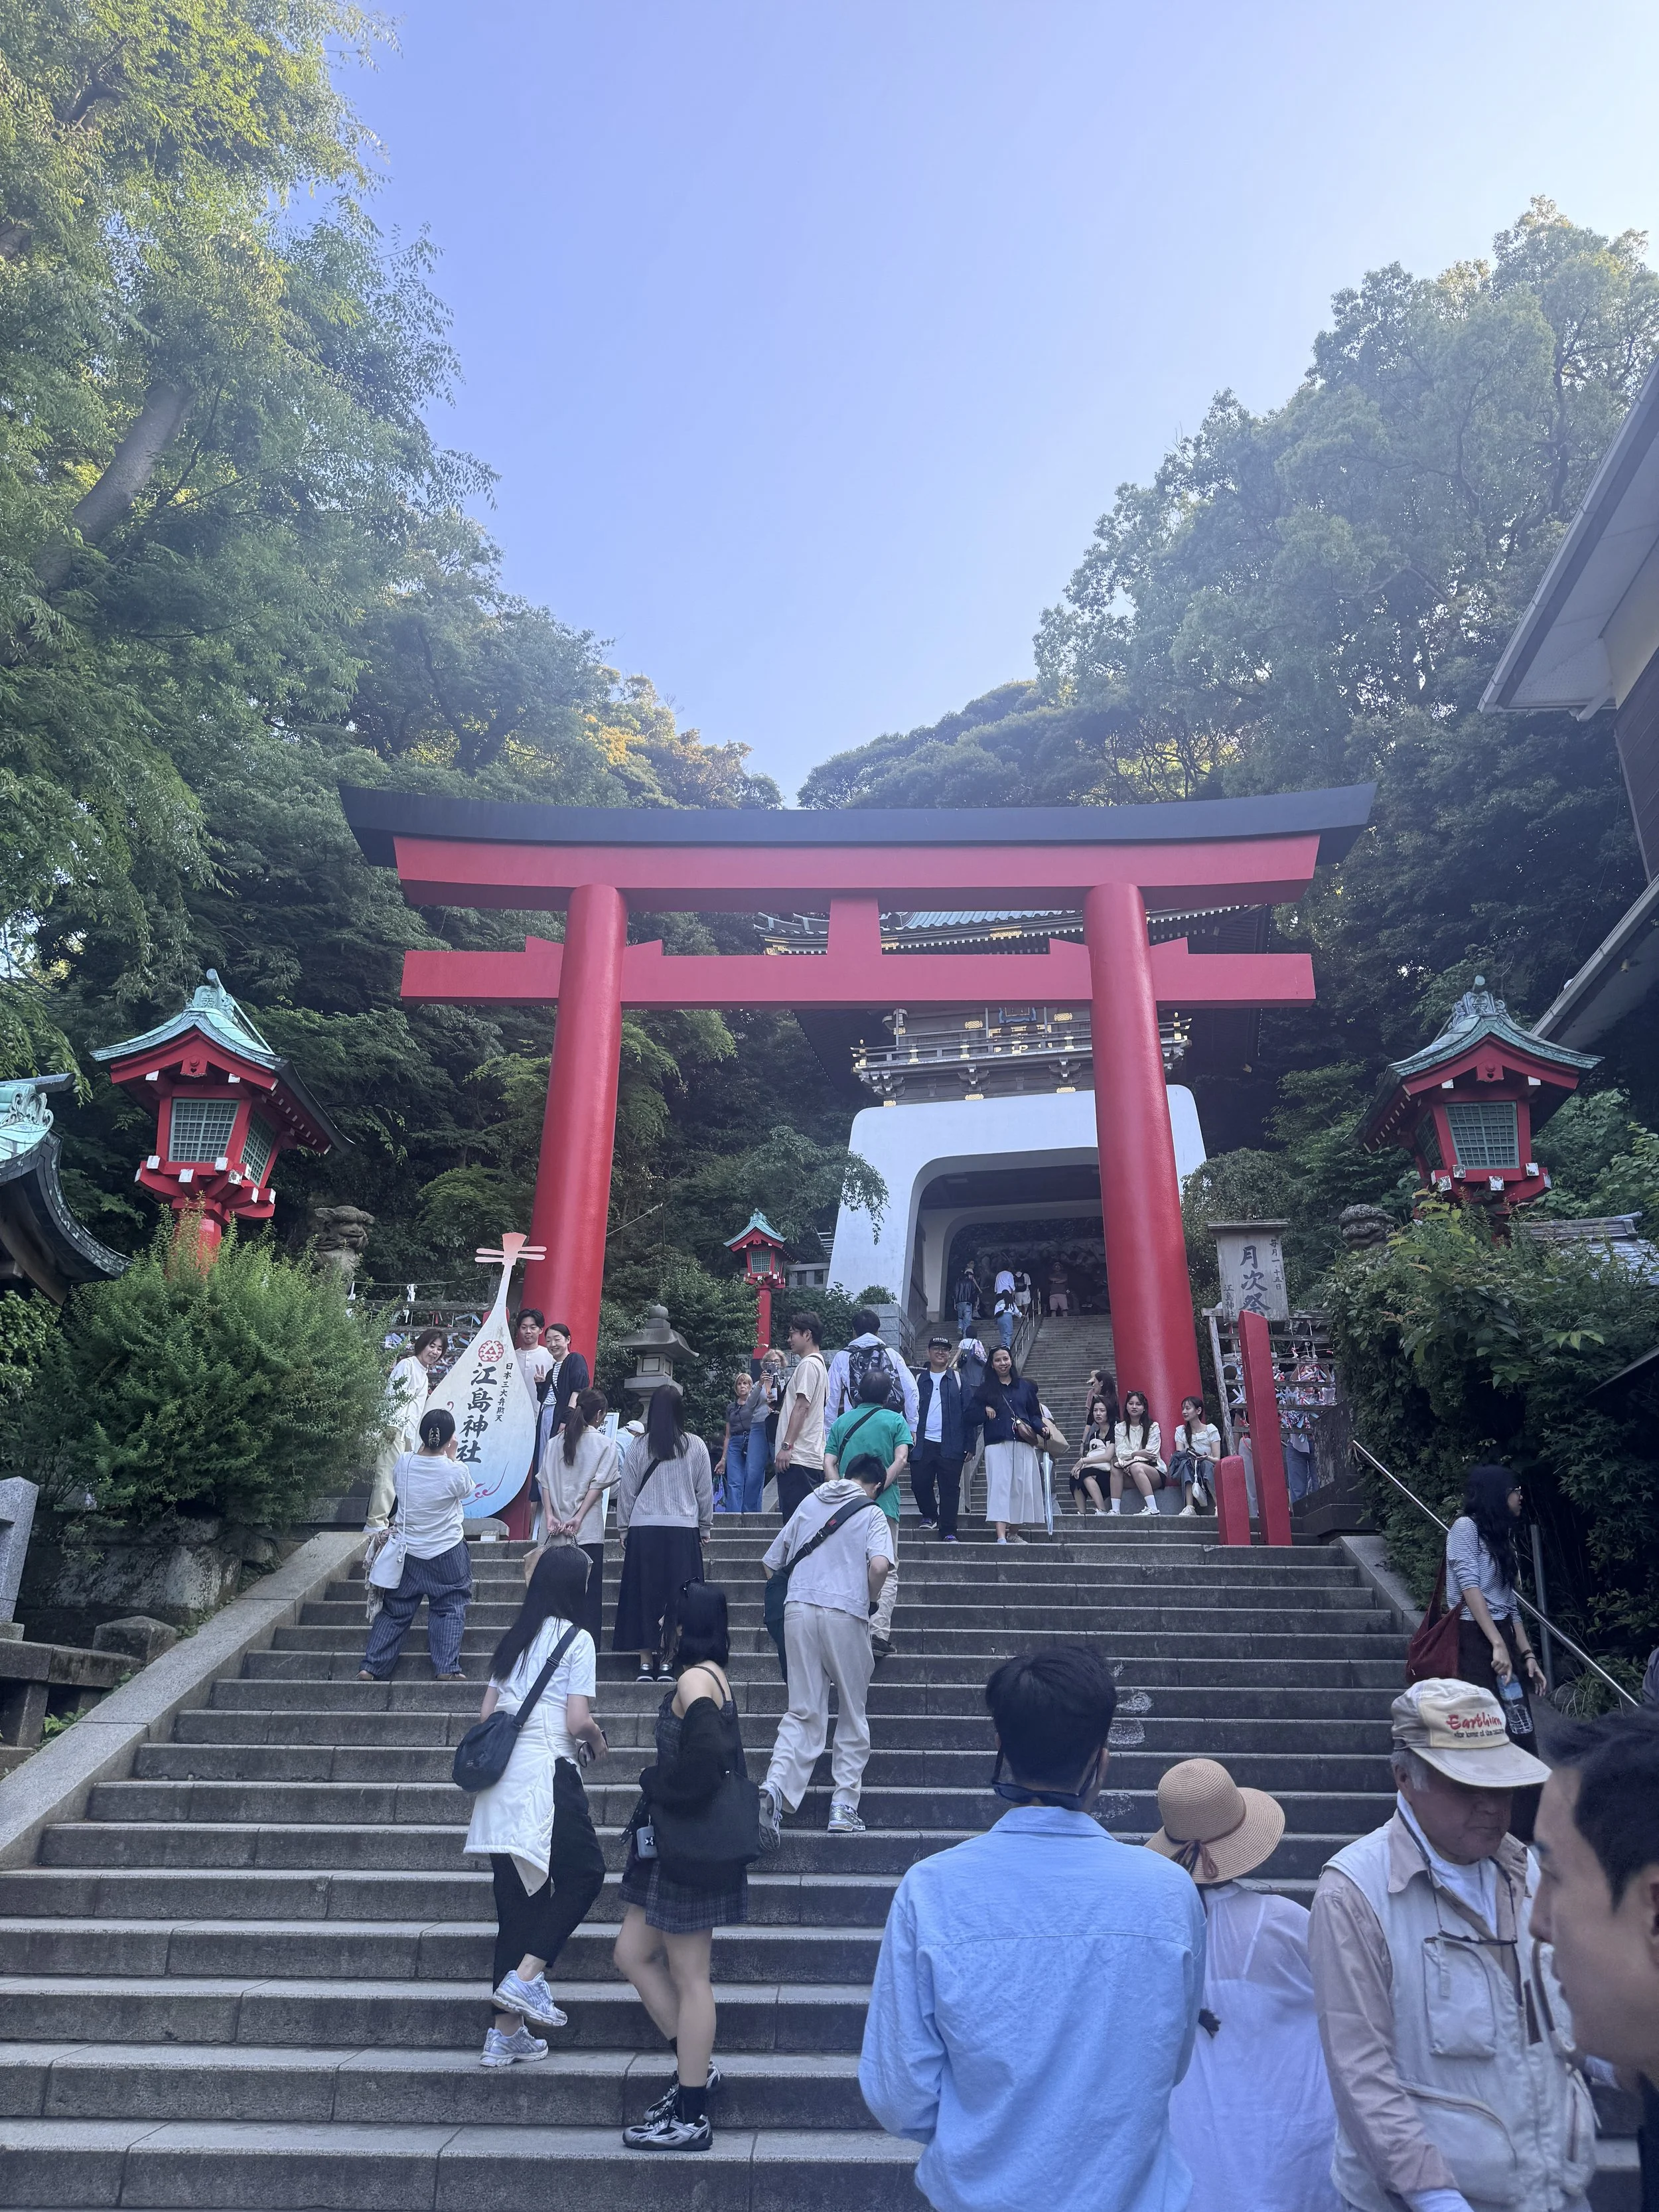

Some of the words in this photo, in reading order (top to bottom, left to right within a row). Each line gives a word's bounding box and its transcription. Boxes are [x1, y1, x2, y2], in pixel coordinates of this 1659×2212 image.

[1239, 1245, 1271, 1317] 月次祭
[456, 1363, 498, 1463] 江島神社
[495, 1363, 514, 1422] 日本三大弁財天
